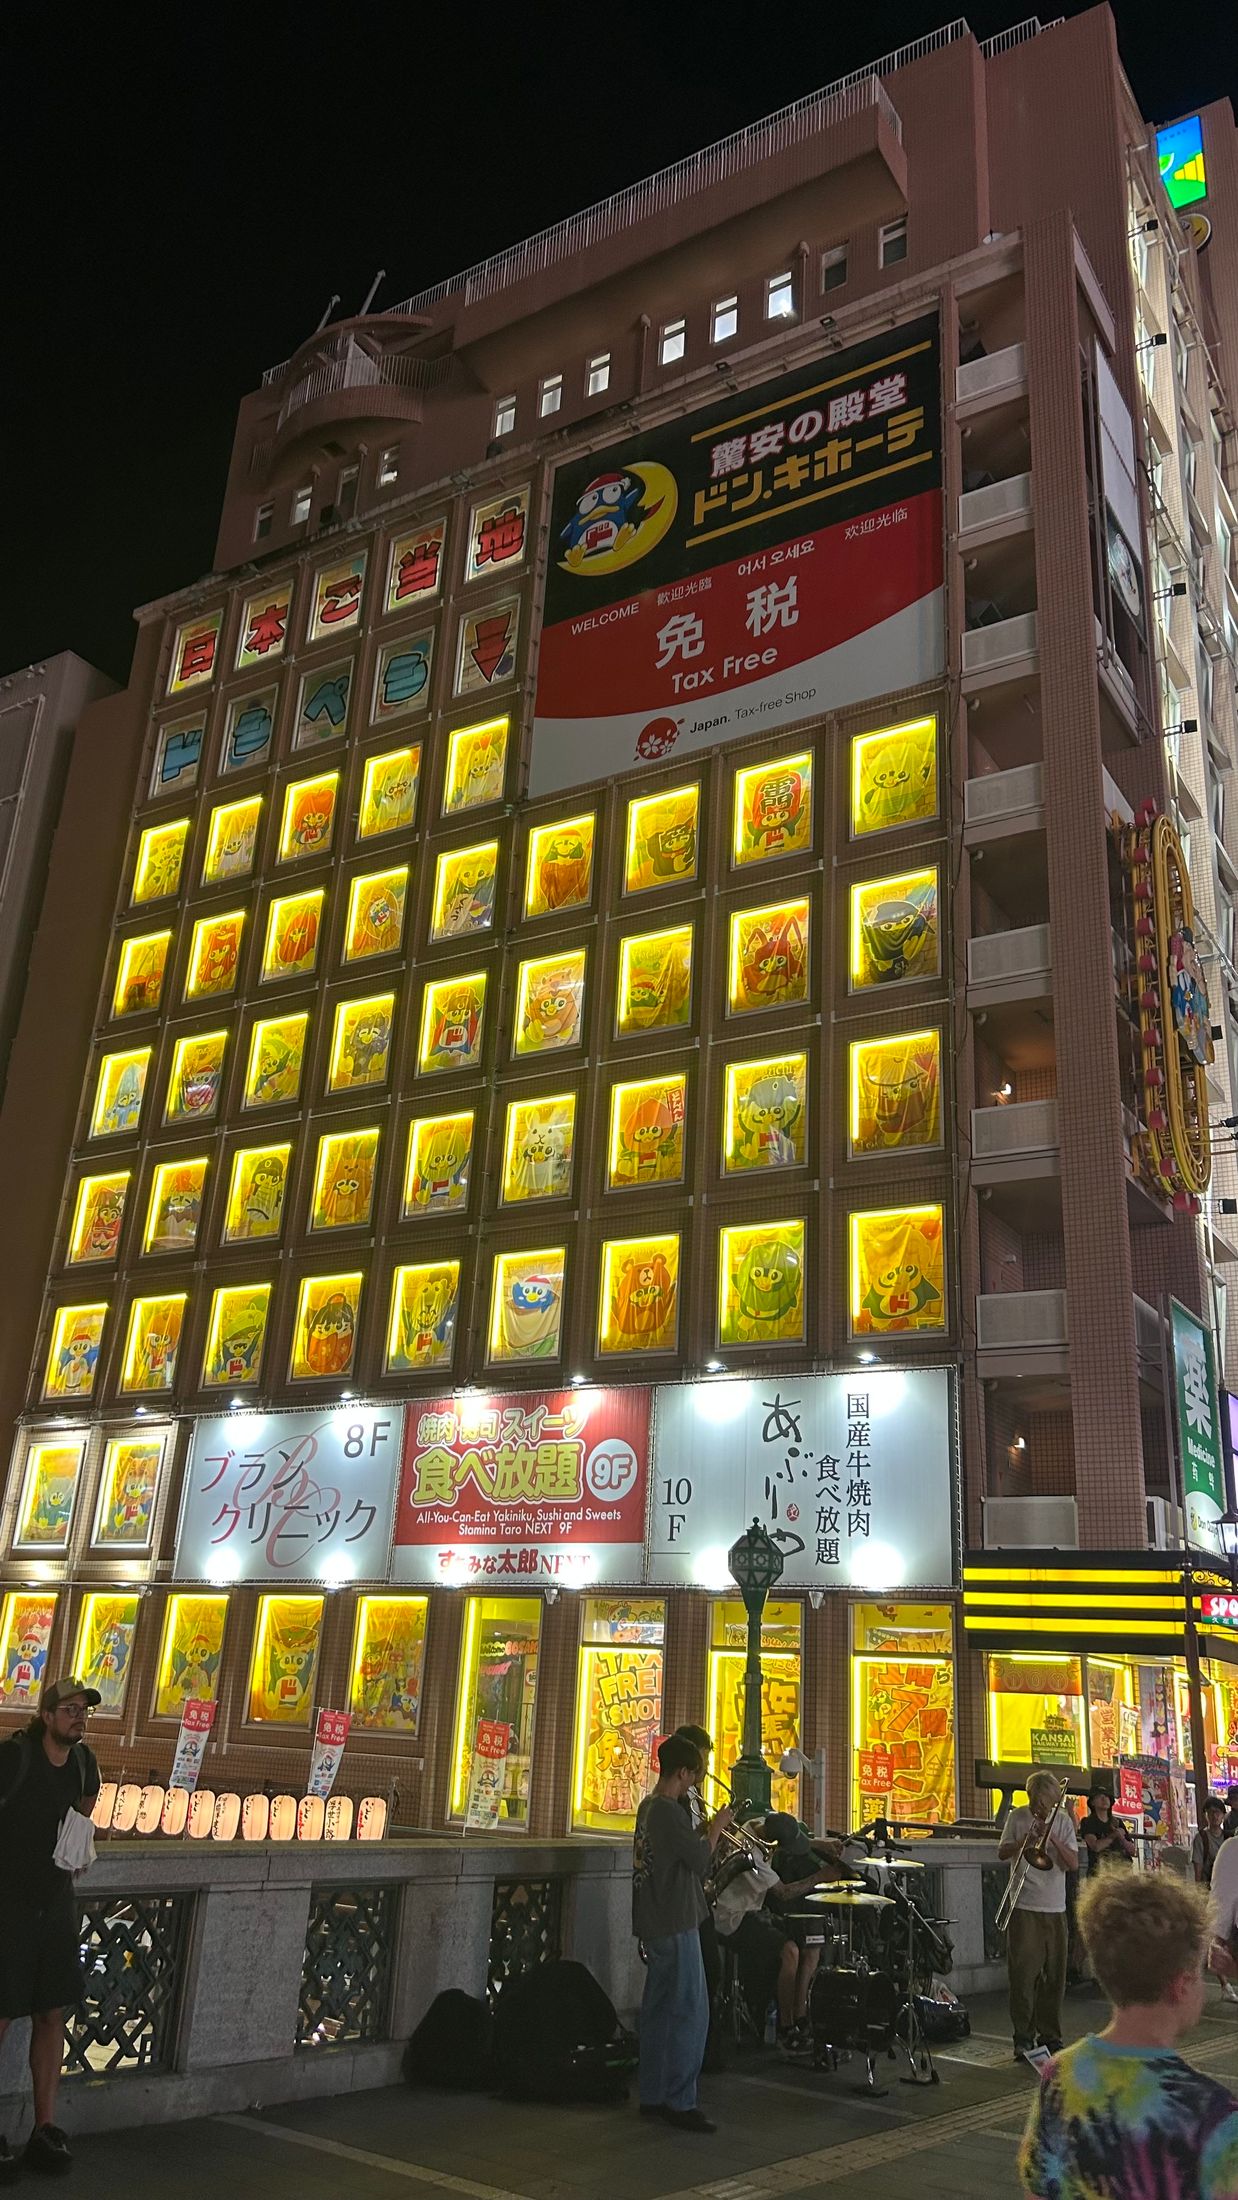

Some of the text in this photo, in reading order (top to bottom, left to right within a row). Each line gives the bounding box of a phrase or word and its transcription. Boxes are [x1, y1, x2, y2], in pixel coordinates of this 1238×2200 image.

[710, 374, 908, 479] 驚安の殿堂
[844, 506, 908, 540] 欢迎光临
[737, 540, 816, 577] 어서 오세요
[571, 603, 638, 635] WELCOME
[672, 647, 778, 694] Tax Free
[690, 686, 817, 734] Japan. Tax-free Shop
[343, 1421, 391, 1459] 8F
[1187, 1436, 1216, 1468] Medicine
[201, 1449, 305, 1492] ブラン
[412, 1441, 582, 1505] 食べ放題
[593, 1453, 632, 1490] 9F
[845, 1393, 872, 1537] 国産牛焼肉
[661, 1478, 692, 1505] 10
[211, 1499, 377, 1544] クリニック
[416, 1506, 622, 1524] All-You-Can-Eat Yakiniku, Sushi and Sweets
[815, 1454, 842, 1566] 食べ放題
[458, 1522, 573, 1536] Stamina Taro NEXT 9F
[667, 1514, 686, 1542] F
[438, 1548, 539, 1574] すみな太郎
[599, 1668, 663, 1706] FRE
[330, 1733, 345, 1742] Free
[477, 1742, 506, 1755] Tax Free
[1032, 1732, 1075, 1743] KANSAI
[860, 1778, 892, 1788] ax Free
[861, 1764, 889, 1779] 免税
[1121, 1798, 1142, 1809] Free
